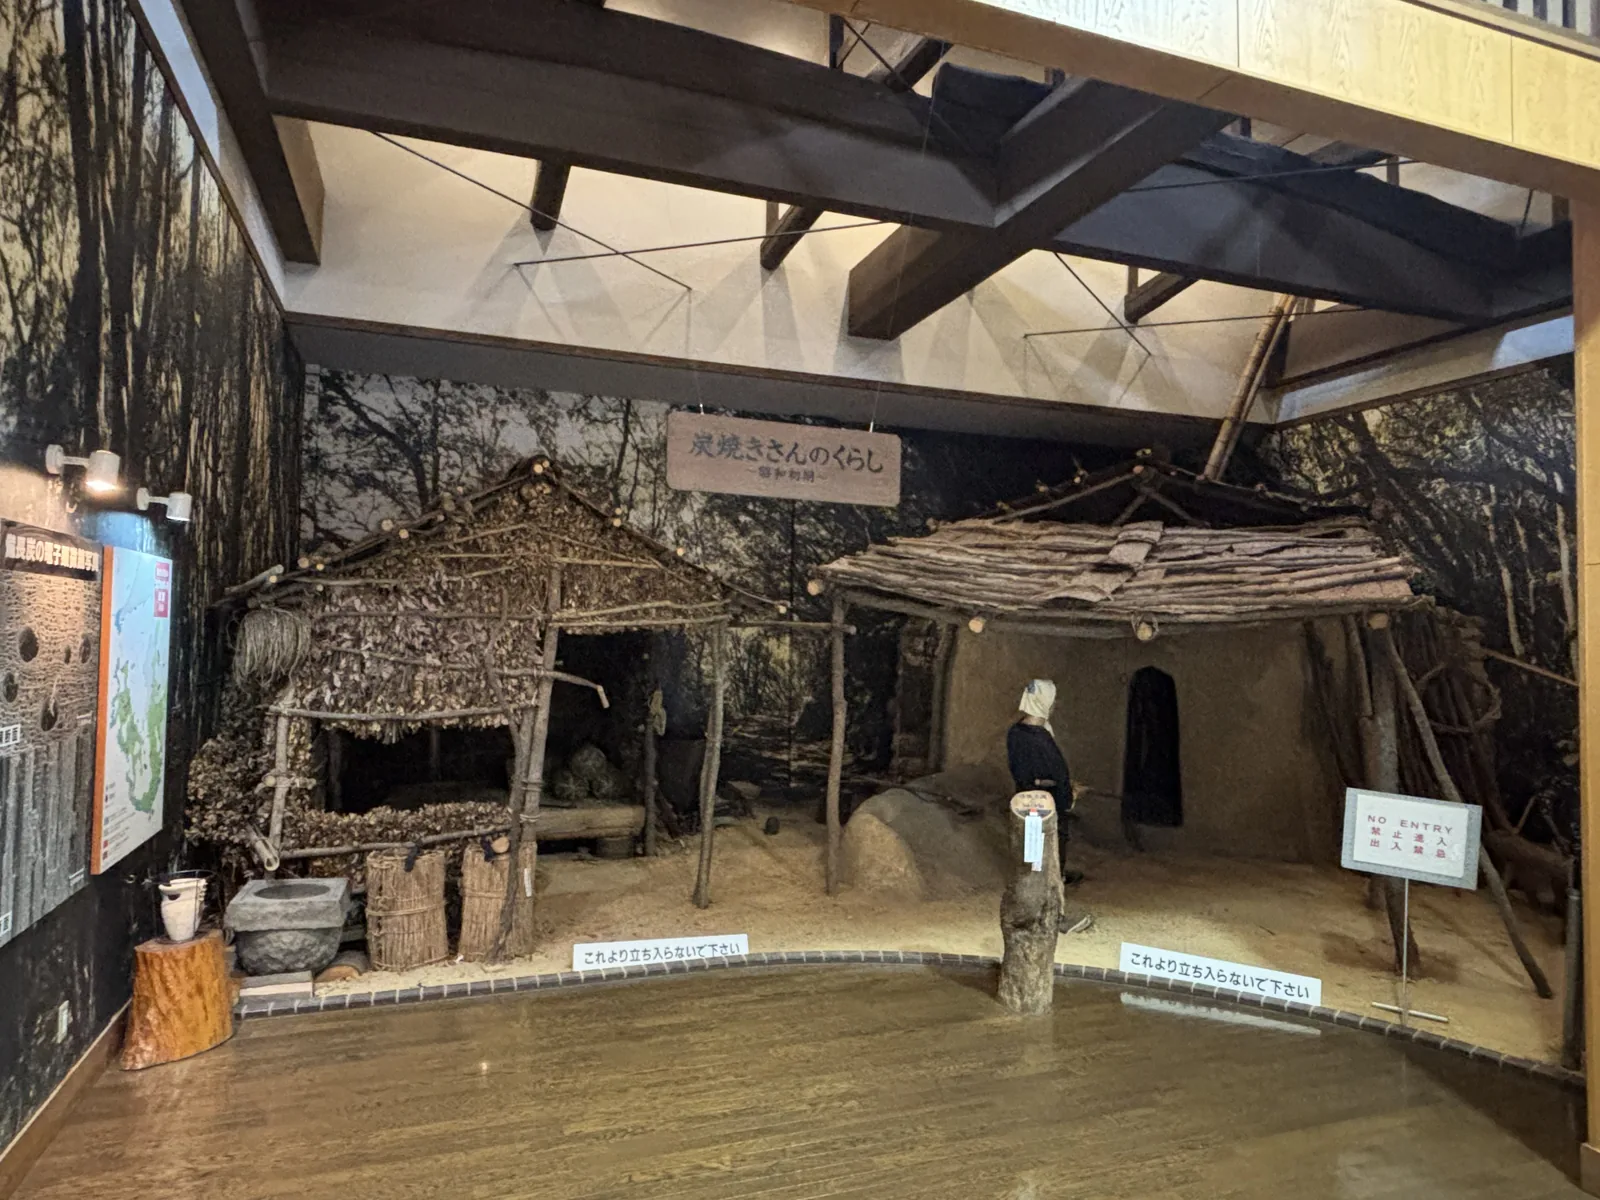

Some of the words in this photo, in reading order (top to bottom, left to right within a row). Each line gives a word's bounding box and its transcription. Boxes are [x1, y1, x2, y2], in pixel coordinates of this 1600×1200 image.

[690, 431, 884, 474] 炭焼きさんのくらし
[1367, 814, 1387, 825] NO
[1400, 819, 1453, 835] ENTRY
[584, 942, 740, 965] これより立ち入らないで下さい
[1130, 952, 1310, 999] これより立ち入らないで下さい
